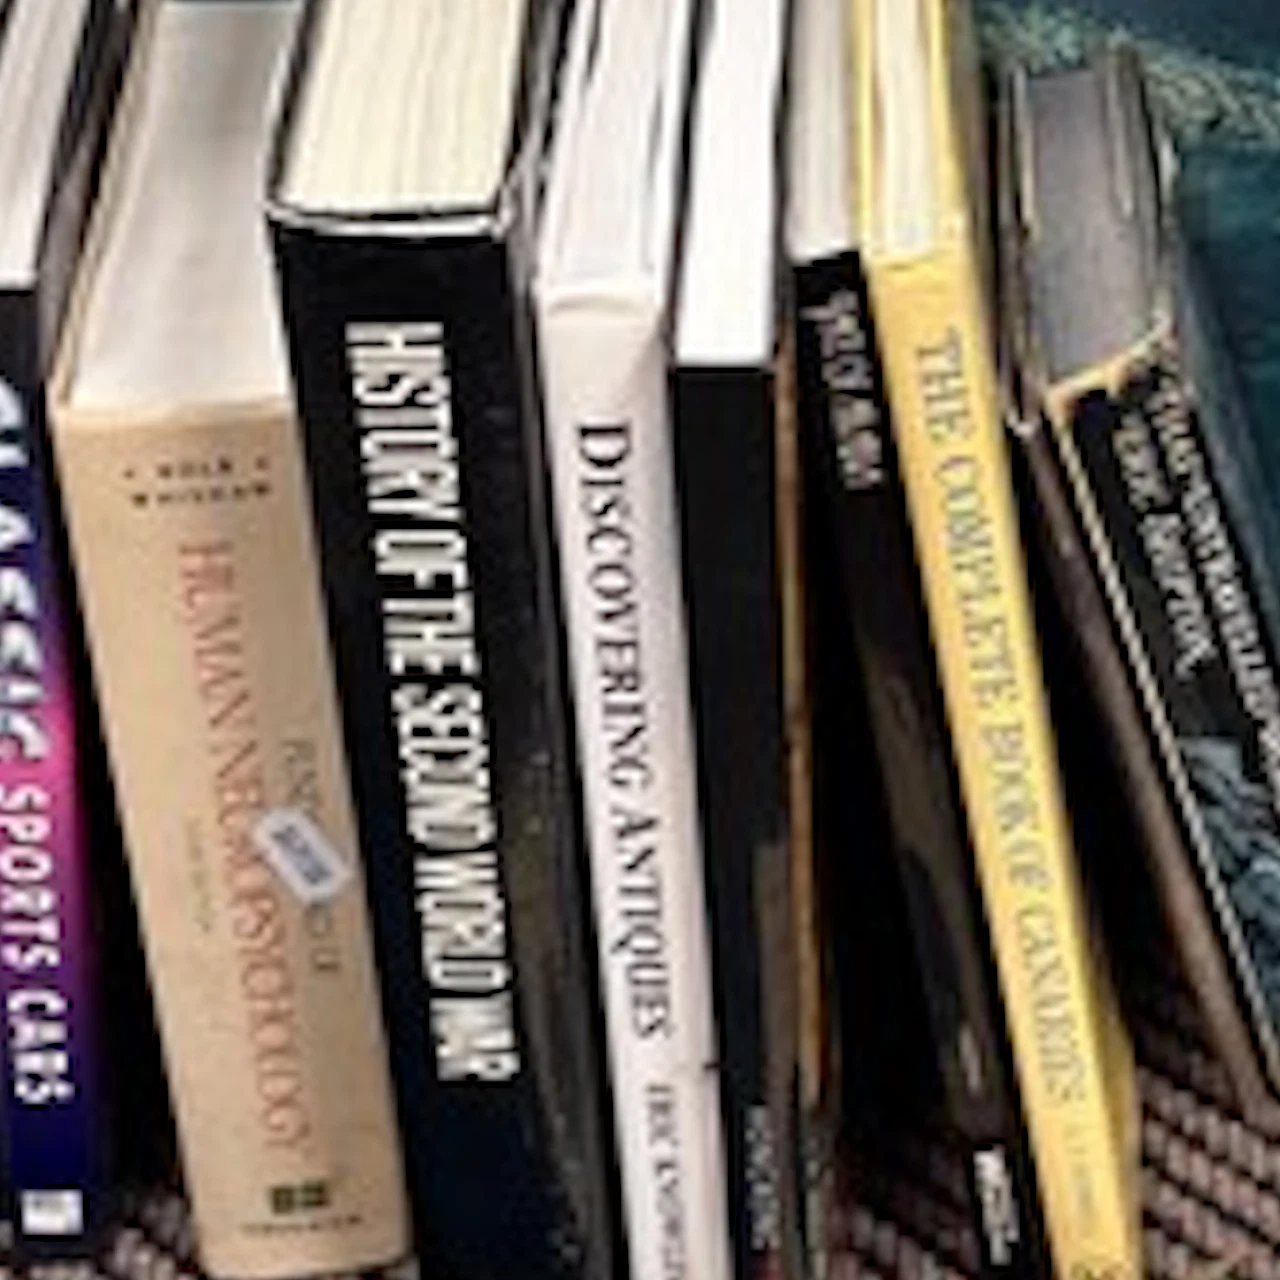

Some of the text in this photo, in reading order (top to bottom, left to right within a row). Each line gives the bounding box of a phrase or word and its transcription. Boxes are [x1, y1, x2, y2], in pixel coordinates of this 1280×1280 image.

[916, 330, 972, 442] THE
[180, 540, 252, 728] HUMAN
[578, 422, 656, 790] DISCOVERING
[930, 452, 1020, 710] COMPLETE
[344, 320, 520, 1082] HISTORY OF THE SECOND WORLD WAR
[610, 804, 674, 1042] ANTIQUES
[5, 986, 78, 1108] CARS
